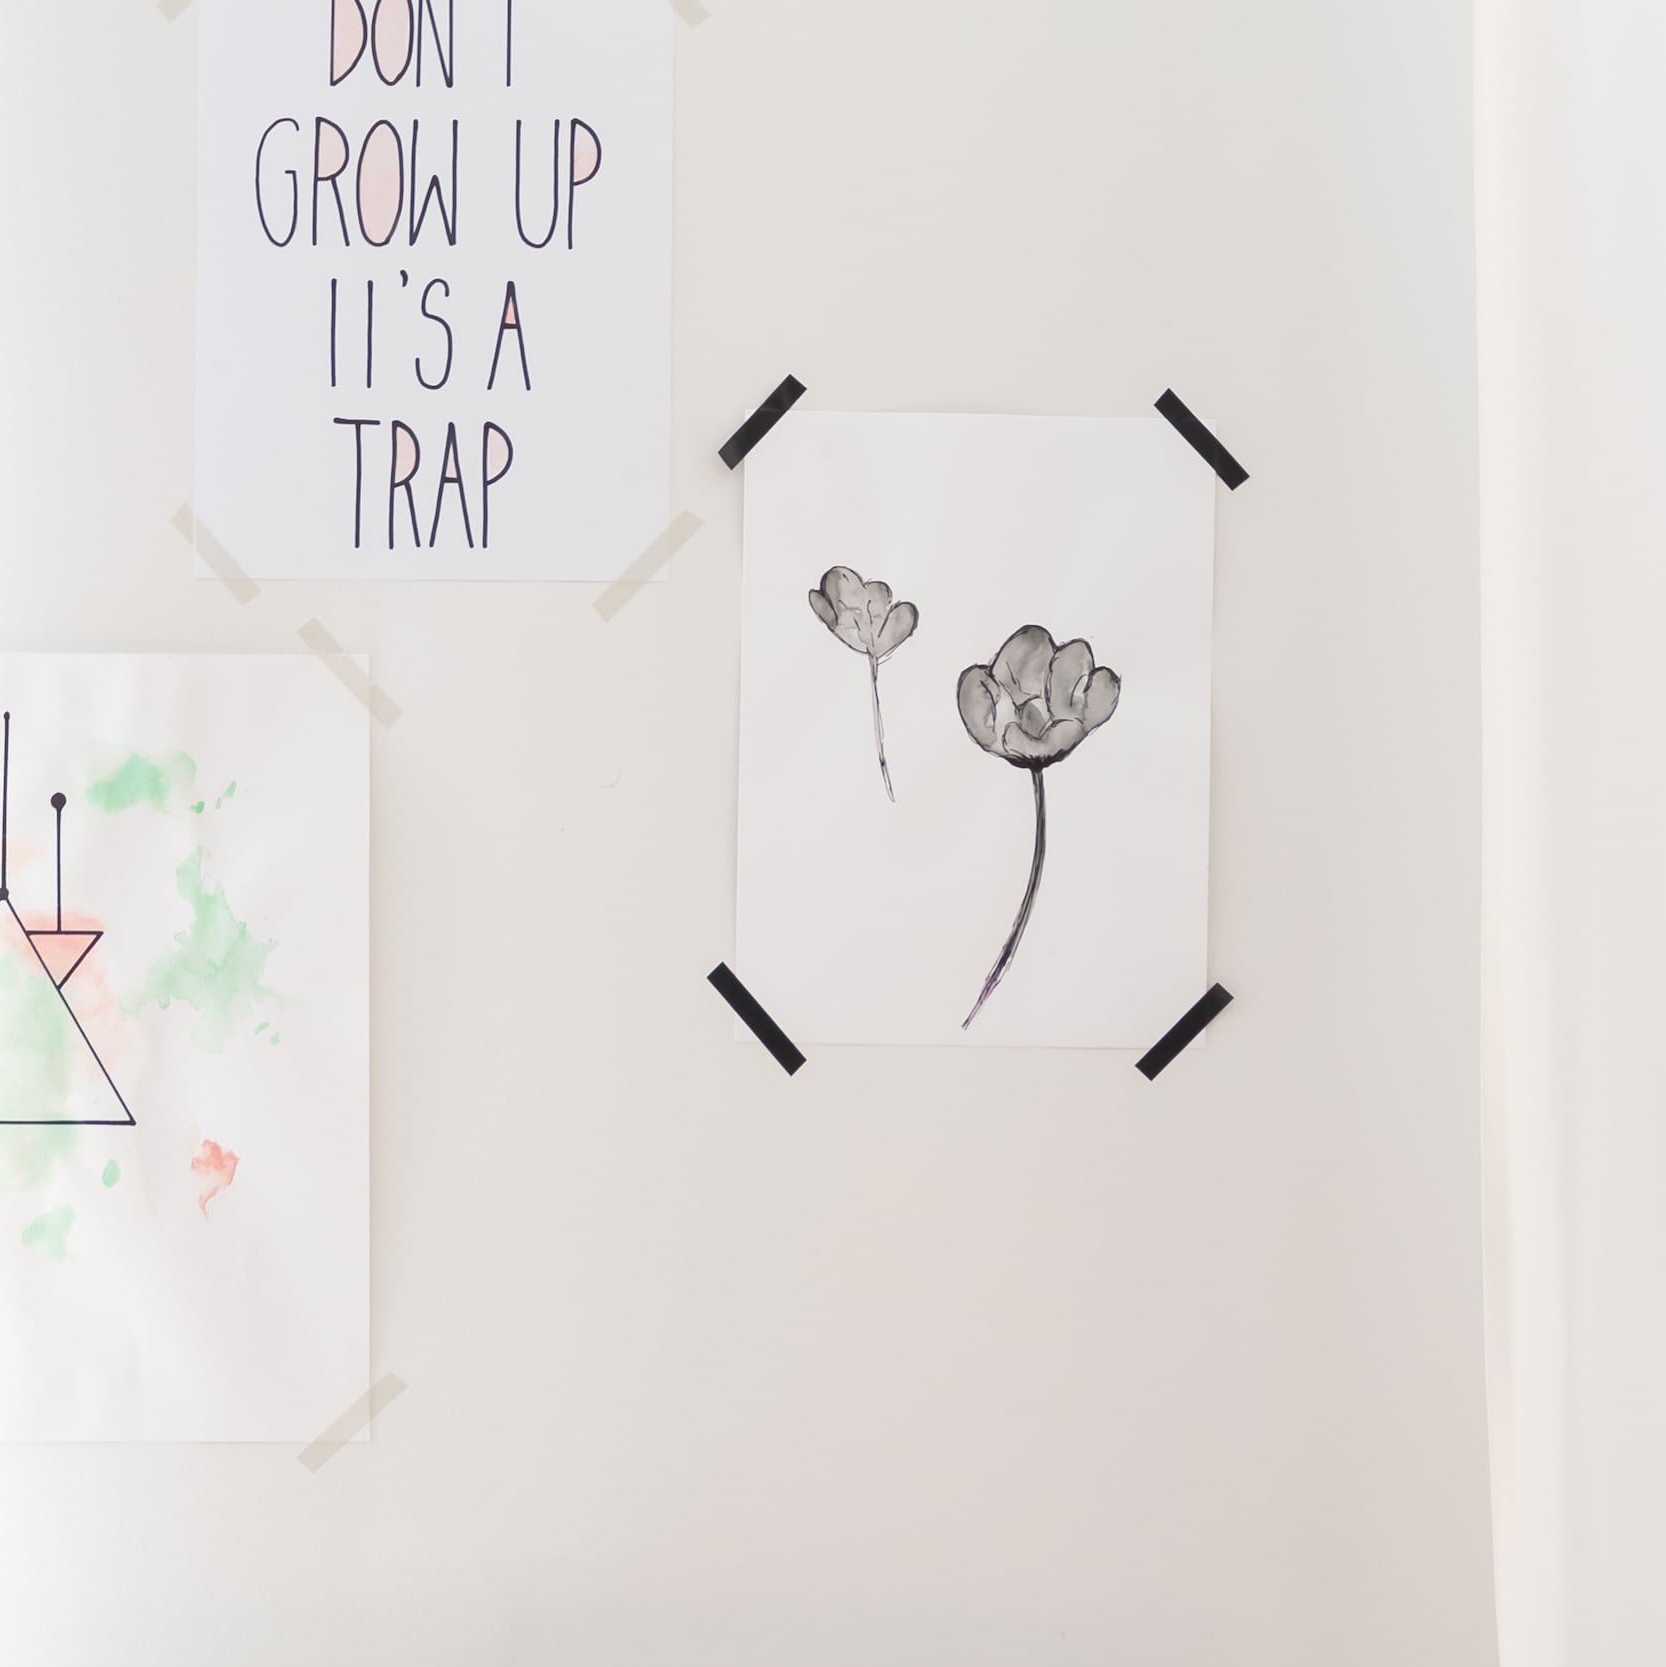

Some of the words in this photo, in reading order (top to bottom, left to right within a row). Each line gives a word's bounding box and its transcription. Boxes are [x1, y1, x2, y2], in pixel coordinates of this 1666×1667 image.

[329, 0, 512, 88] DON
[255, 117, 459, 248] GROW
[515, 118, 602, 250] UP
[486, 281, 531, 391] A
[333, 417, 514, 550] TRAP
